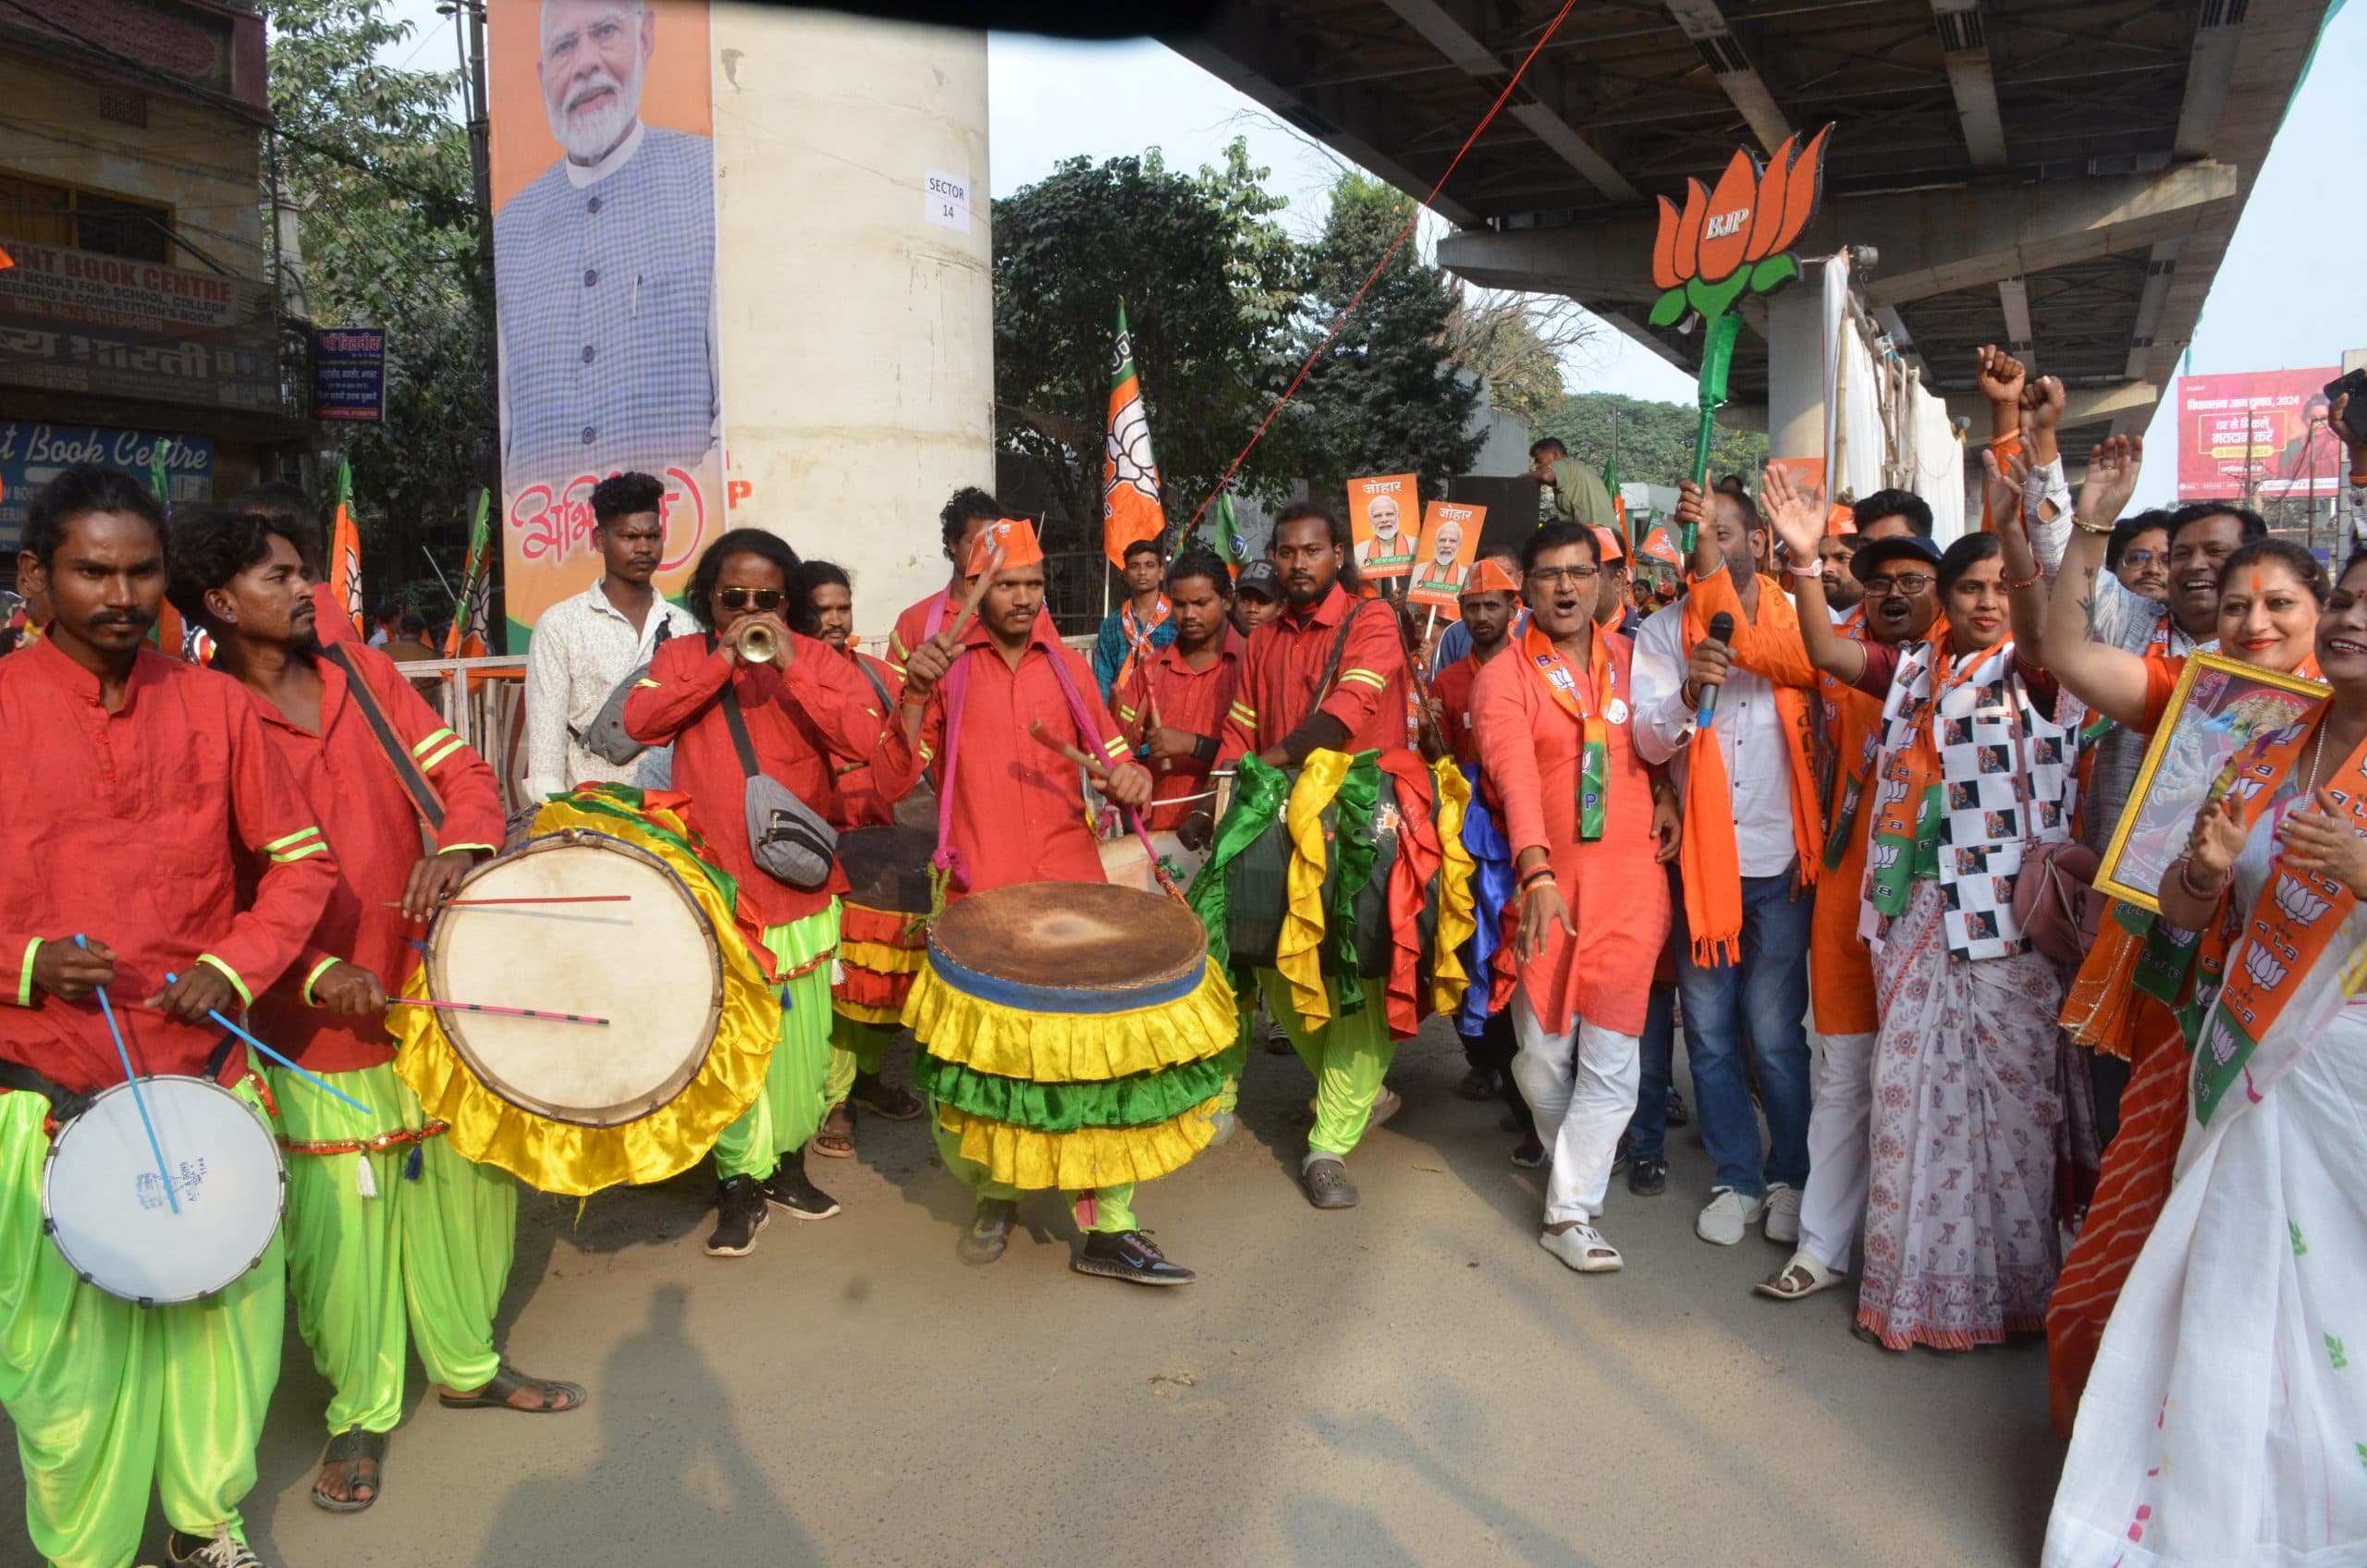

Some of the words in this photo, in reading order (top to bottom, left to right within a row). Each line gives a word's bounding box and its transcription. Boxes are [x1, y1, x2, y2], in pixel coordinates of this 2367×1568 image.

[929, 177, 964, 201] SECTOR
[943, 203, 954, 218] 14
[1705, 207, 1749, 239] BJP
[64, 252, 138, 287] BOOK
[142, 266, 231, 303] CENTRE
[24, 271, 74, 290] BOOKS
[172, 297, 227, 315] COLLEGE
[181, 309, 215, 325] BOOK
[2276, 396, 2300, 406] 2024
[25, 423, 105, 463] Book
[1362, 479, 1403, 495] जोहार
[1439, 504, 1473, 521] जोहार
